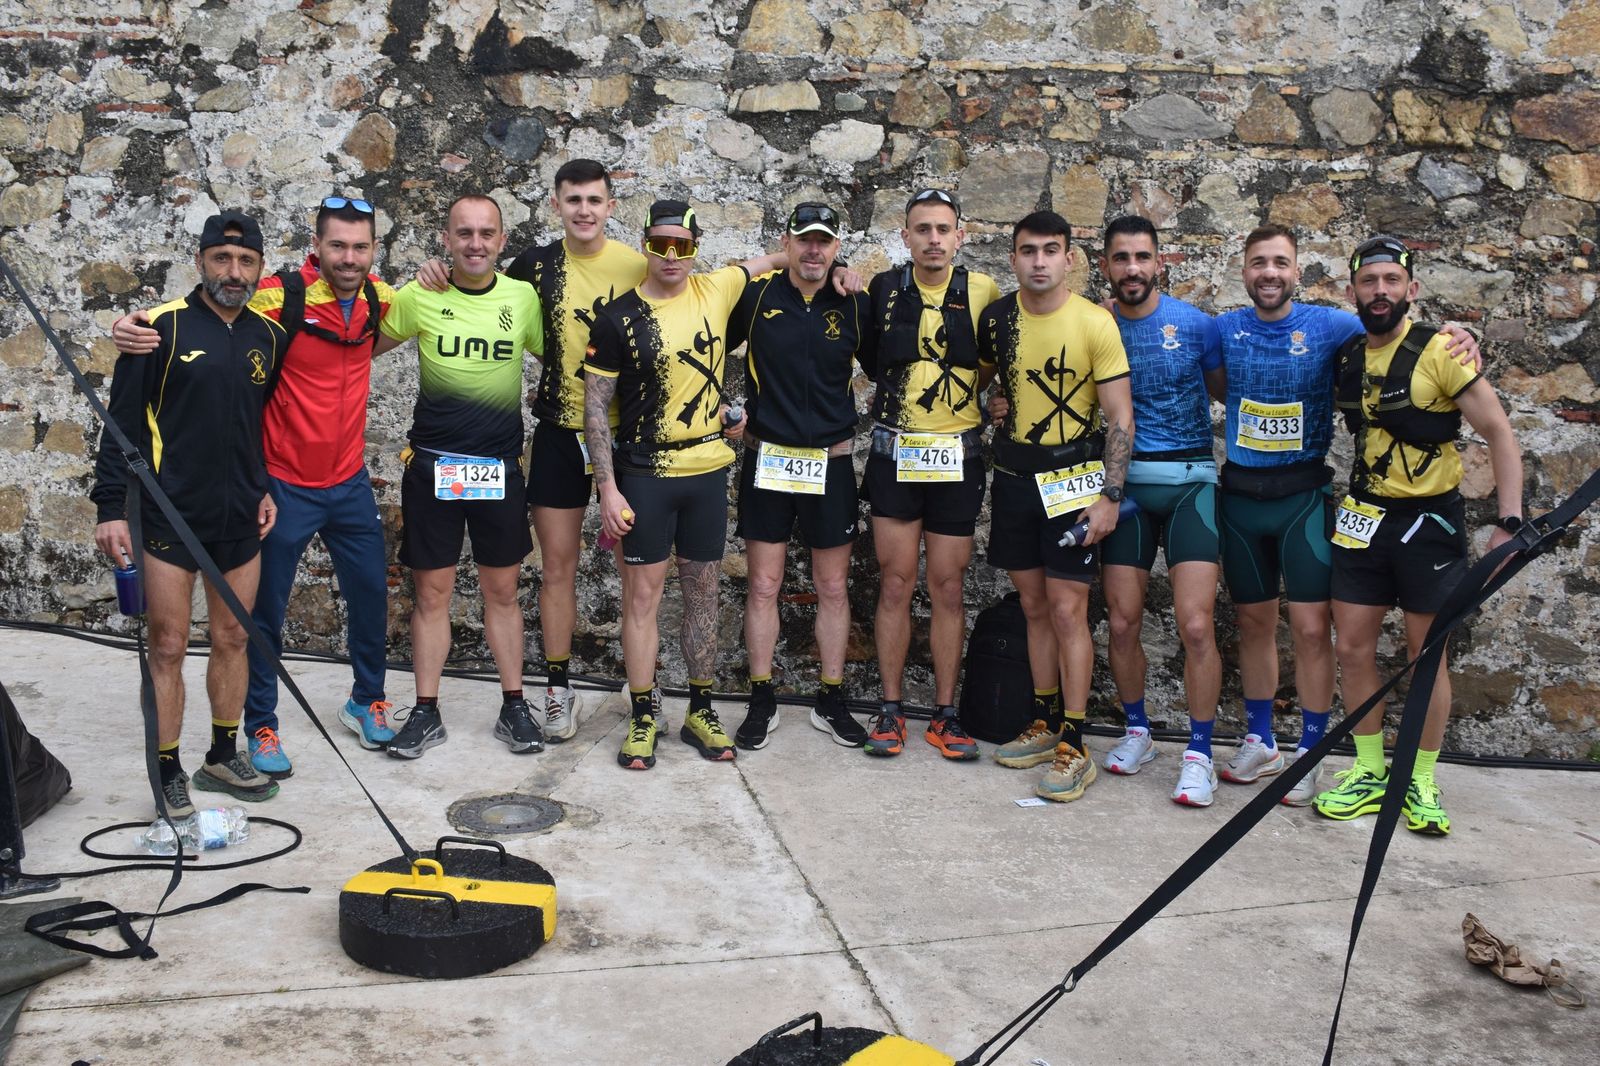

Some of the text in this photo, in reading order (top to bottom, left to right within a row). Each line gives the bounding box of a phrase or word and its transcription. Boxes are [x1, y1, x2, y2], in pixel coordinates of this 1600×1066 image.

[437, 334, 514, 361] UME
[1258, 417, 1300, 435] 4333
[921, 448, 957, 466] 4761
[460, 465, 500, 483] 1324
[784, 458, 824, 478] 4312
[1066, 472, 1105, 494] 4783
[1340, 511, 1374, 536] 4351
